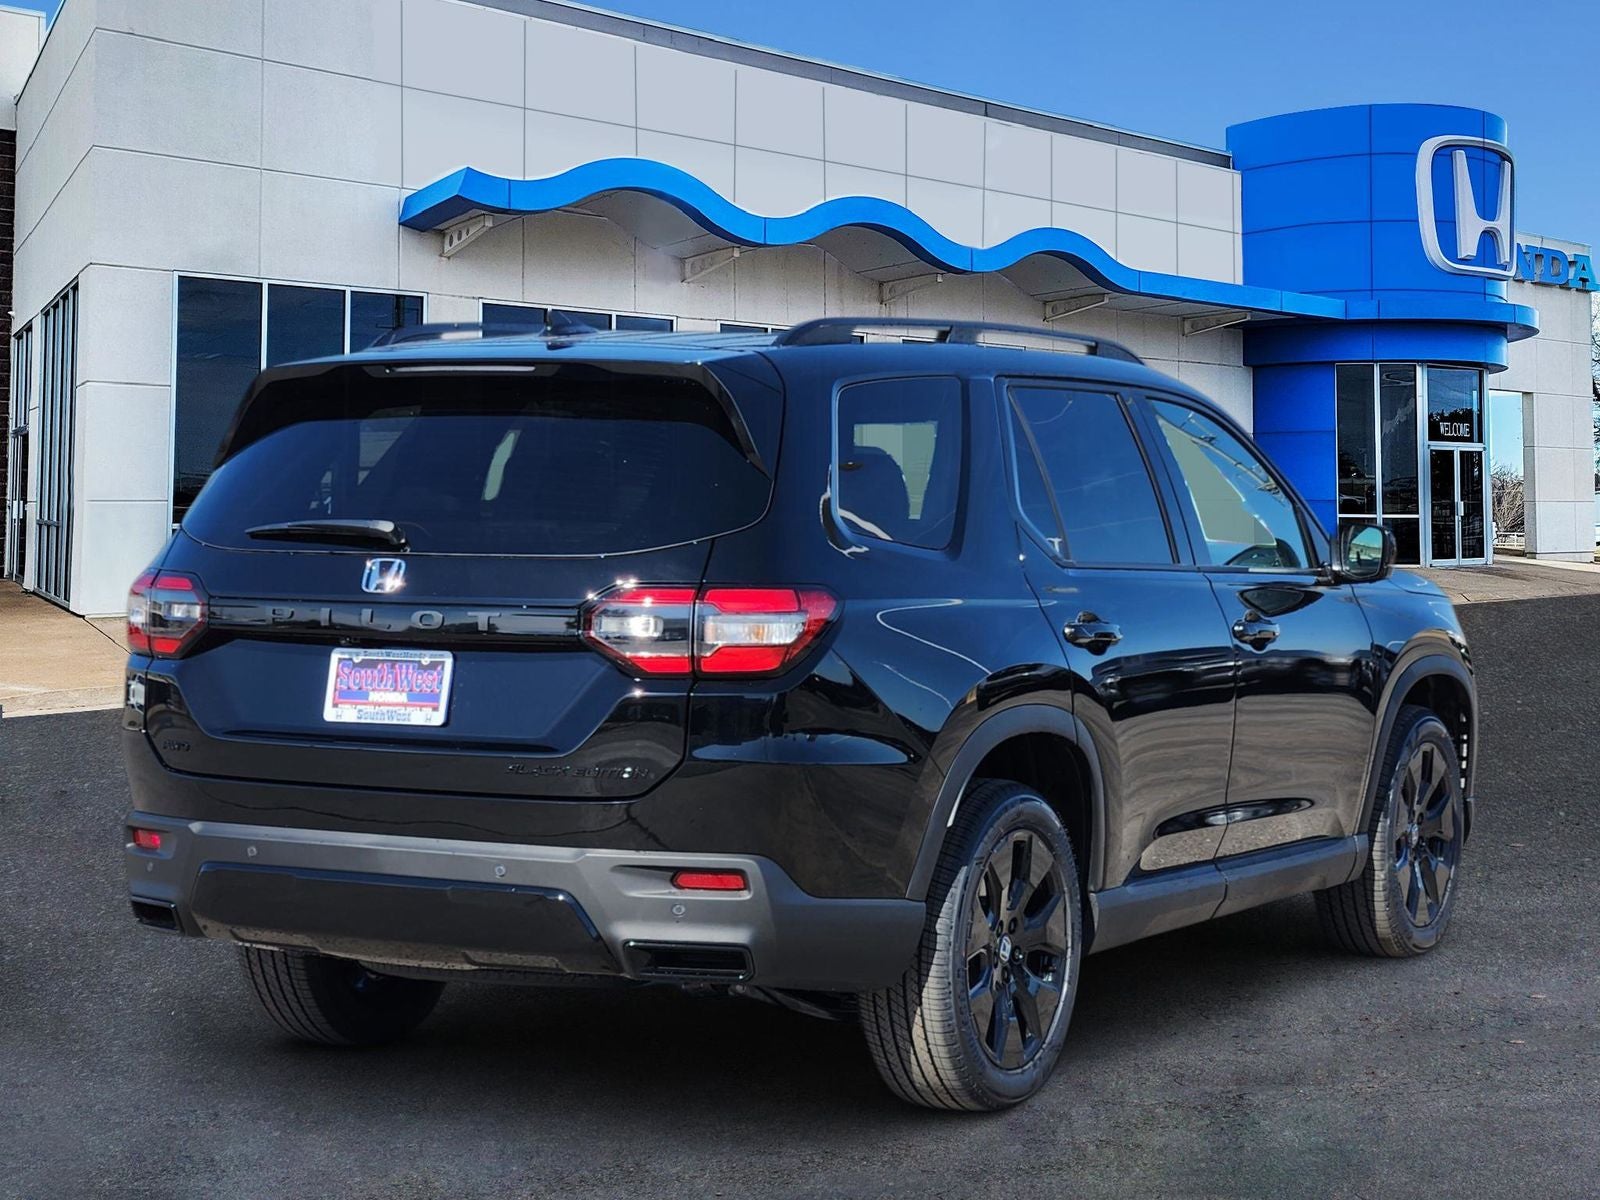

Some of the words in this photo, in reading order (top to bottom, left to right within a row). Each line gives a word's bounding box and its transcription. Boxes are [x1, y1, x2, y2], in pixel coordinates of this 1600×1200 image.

[1514, 243, 1600, 292] NDA
[1439, 422, 1471, 437] WELCOME
[265, 607, 501, 633] PILOT
[338, 661, 443, 692] SouthWest
[356, 709, 412, 722] SouthWest
[506, 763, 570, 777] BLACK
[573, 766, 649, 779] EDITION
